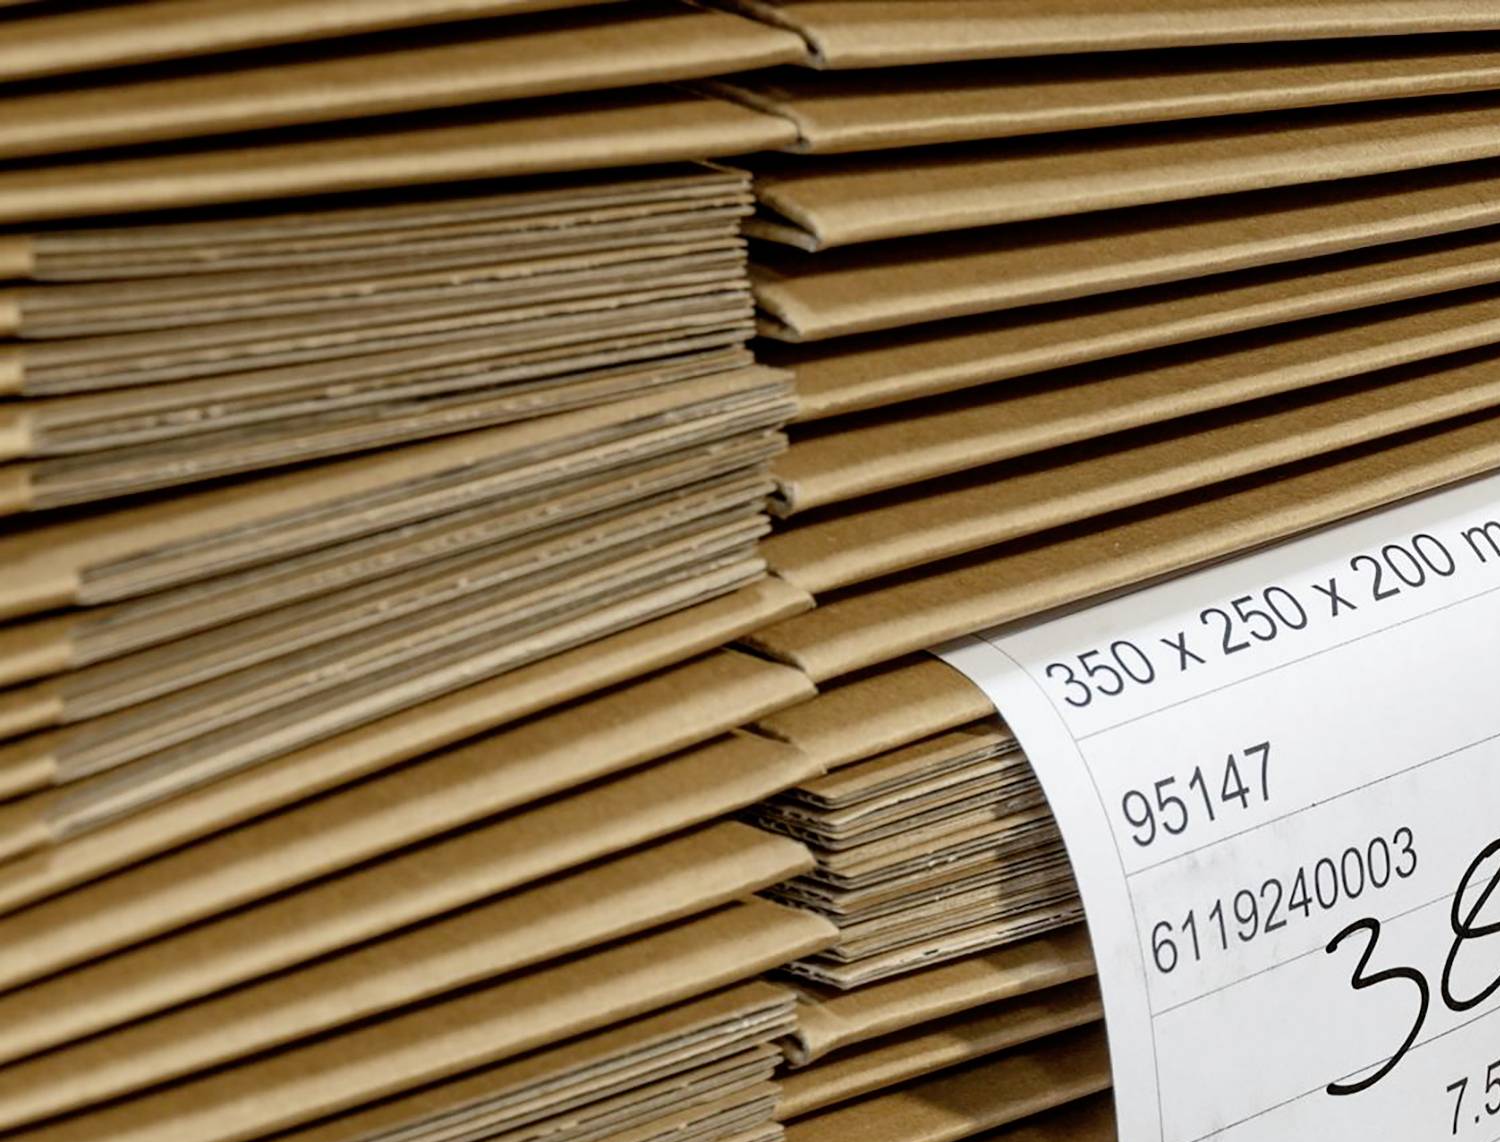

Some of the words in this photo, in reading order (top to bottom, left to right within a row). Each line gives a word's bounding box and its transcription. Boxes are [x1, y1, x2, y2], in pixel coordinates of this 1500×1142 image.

[1045, 640, 1156, 708] 350
[1159, 631, 1207, 672] x
[1199, 586, 1308, 656] 250
[1311, 577, 1358, 618] x
[1349, 533, 1456, 602] 200
[1121, 740, 1272, 848] 95147
[1151, 826, 1418, 975] 6119240003
